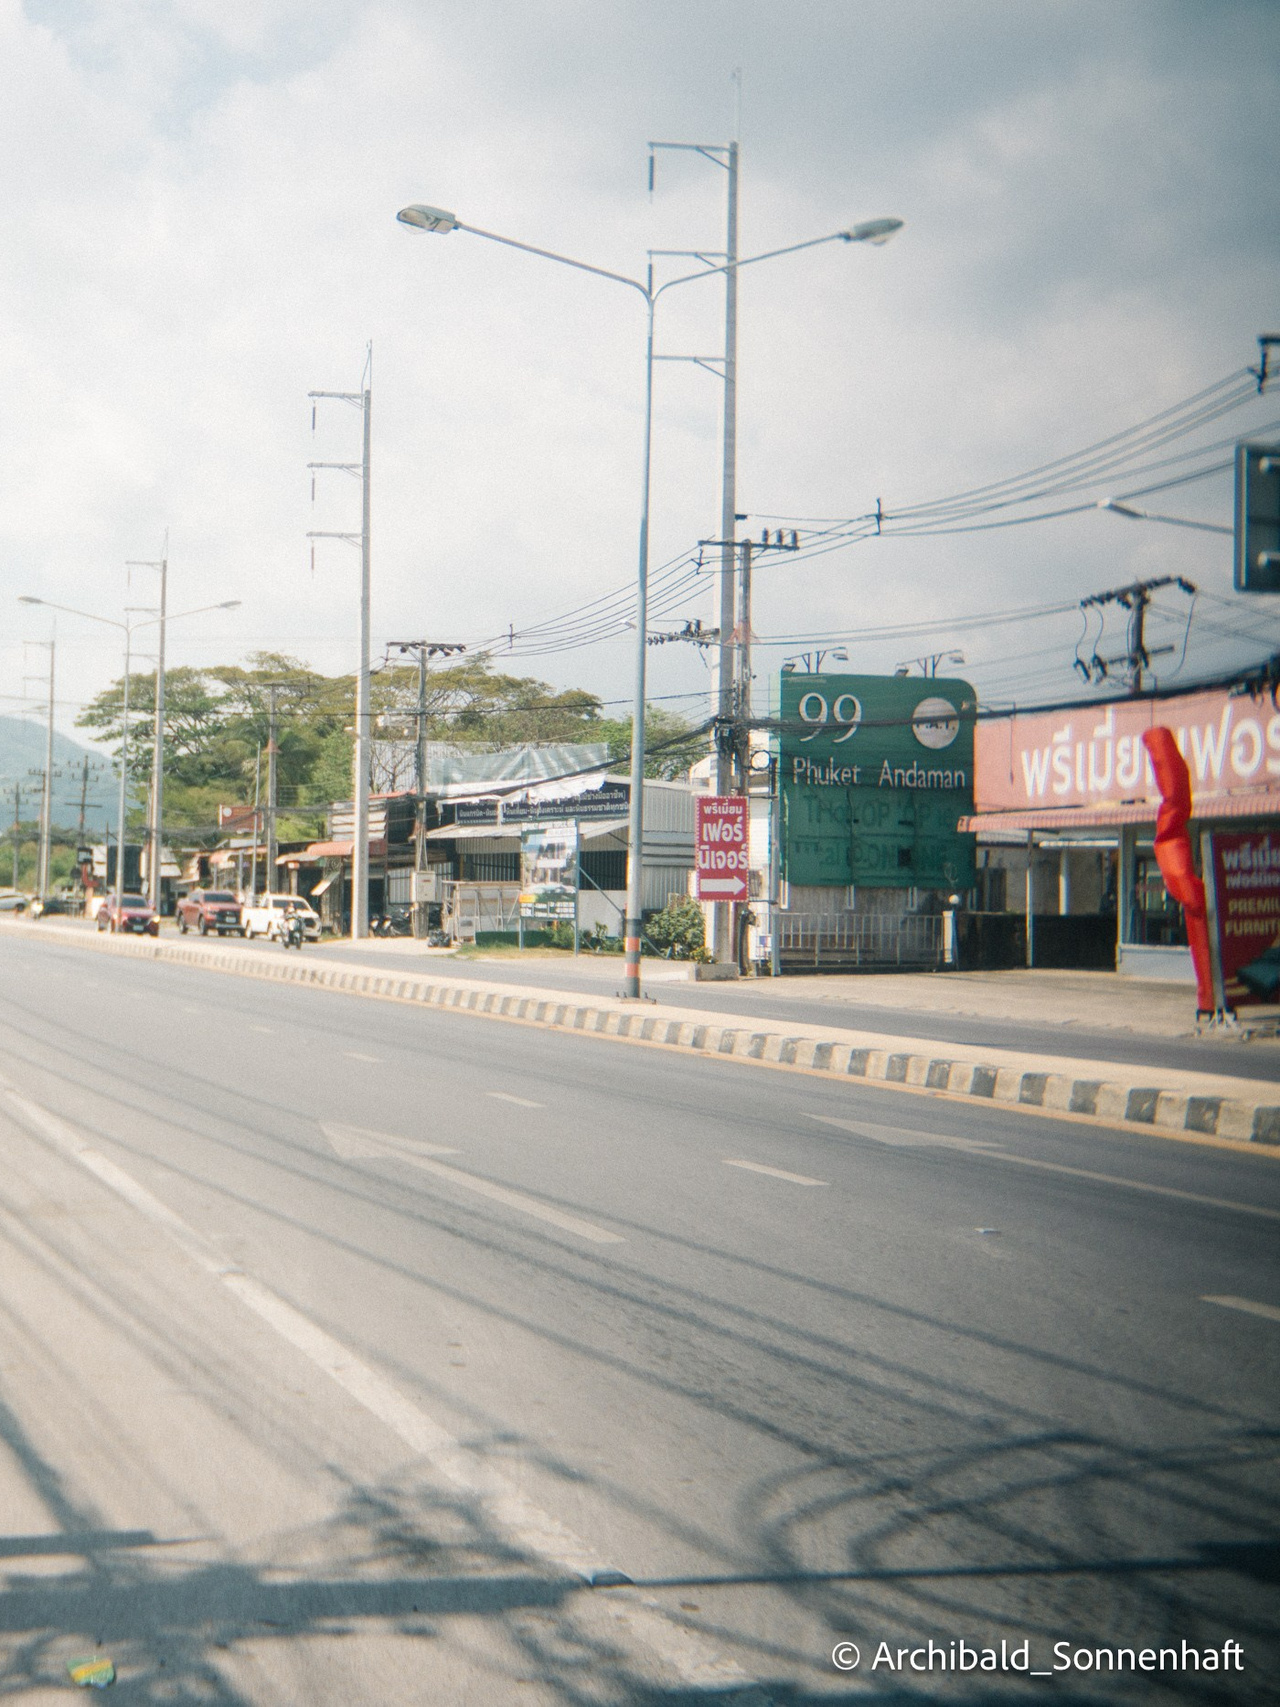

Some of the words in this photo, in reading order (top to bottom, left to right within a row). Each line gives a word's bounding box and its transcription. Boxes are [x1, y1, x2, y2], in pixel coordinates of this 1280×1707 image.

[799, 692, 862, 743] 99
[792, 756, 862, 786] Phuket
[878, 758, 966, 789] Andaman
[703, 816, 744, 842] เฟอร์
[699, 843, 749, 870] นิเจอร์
